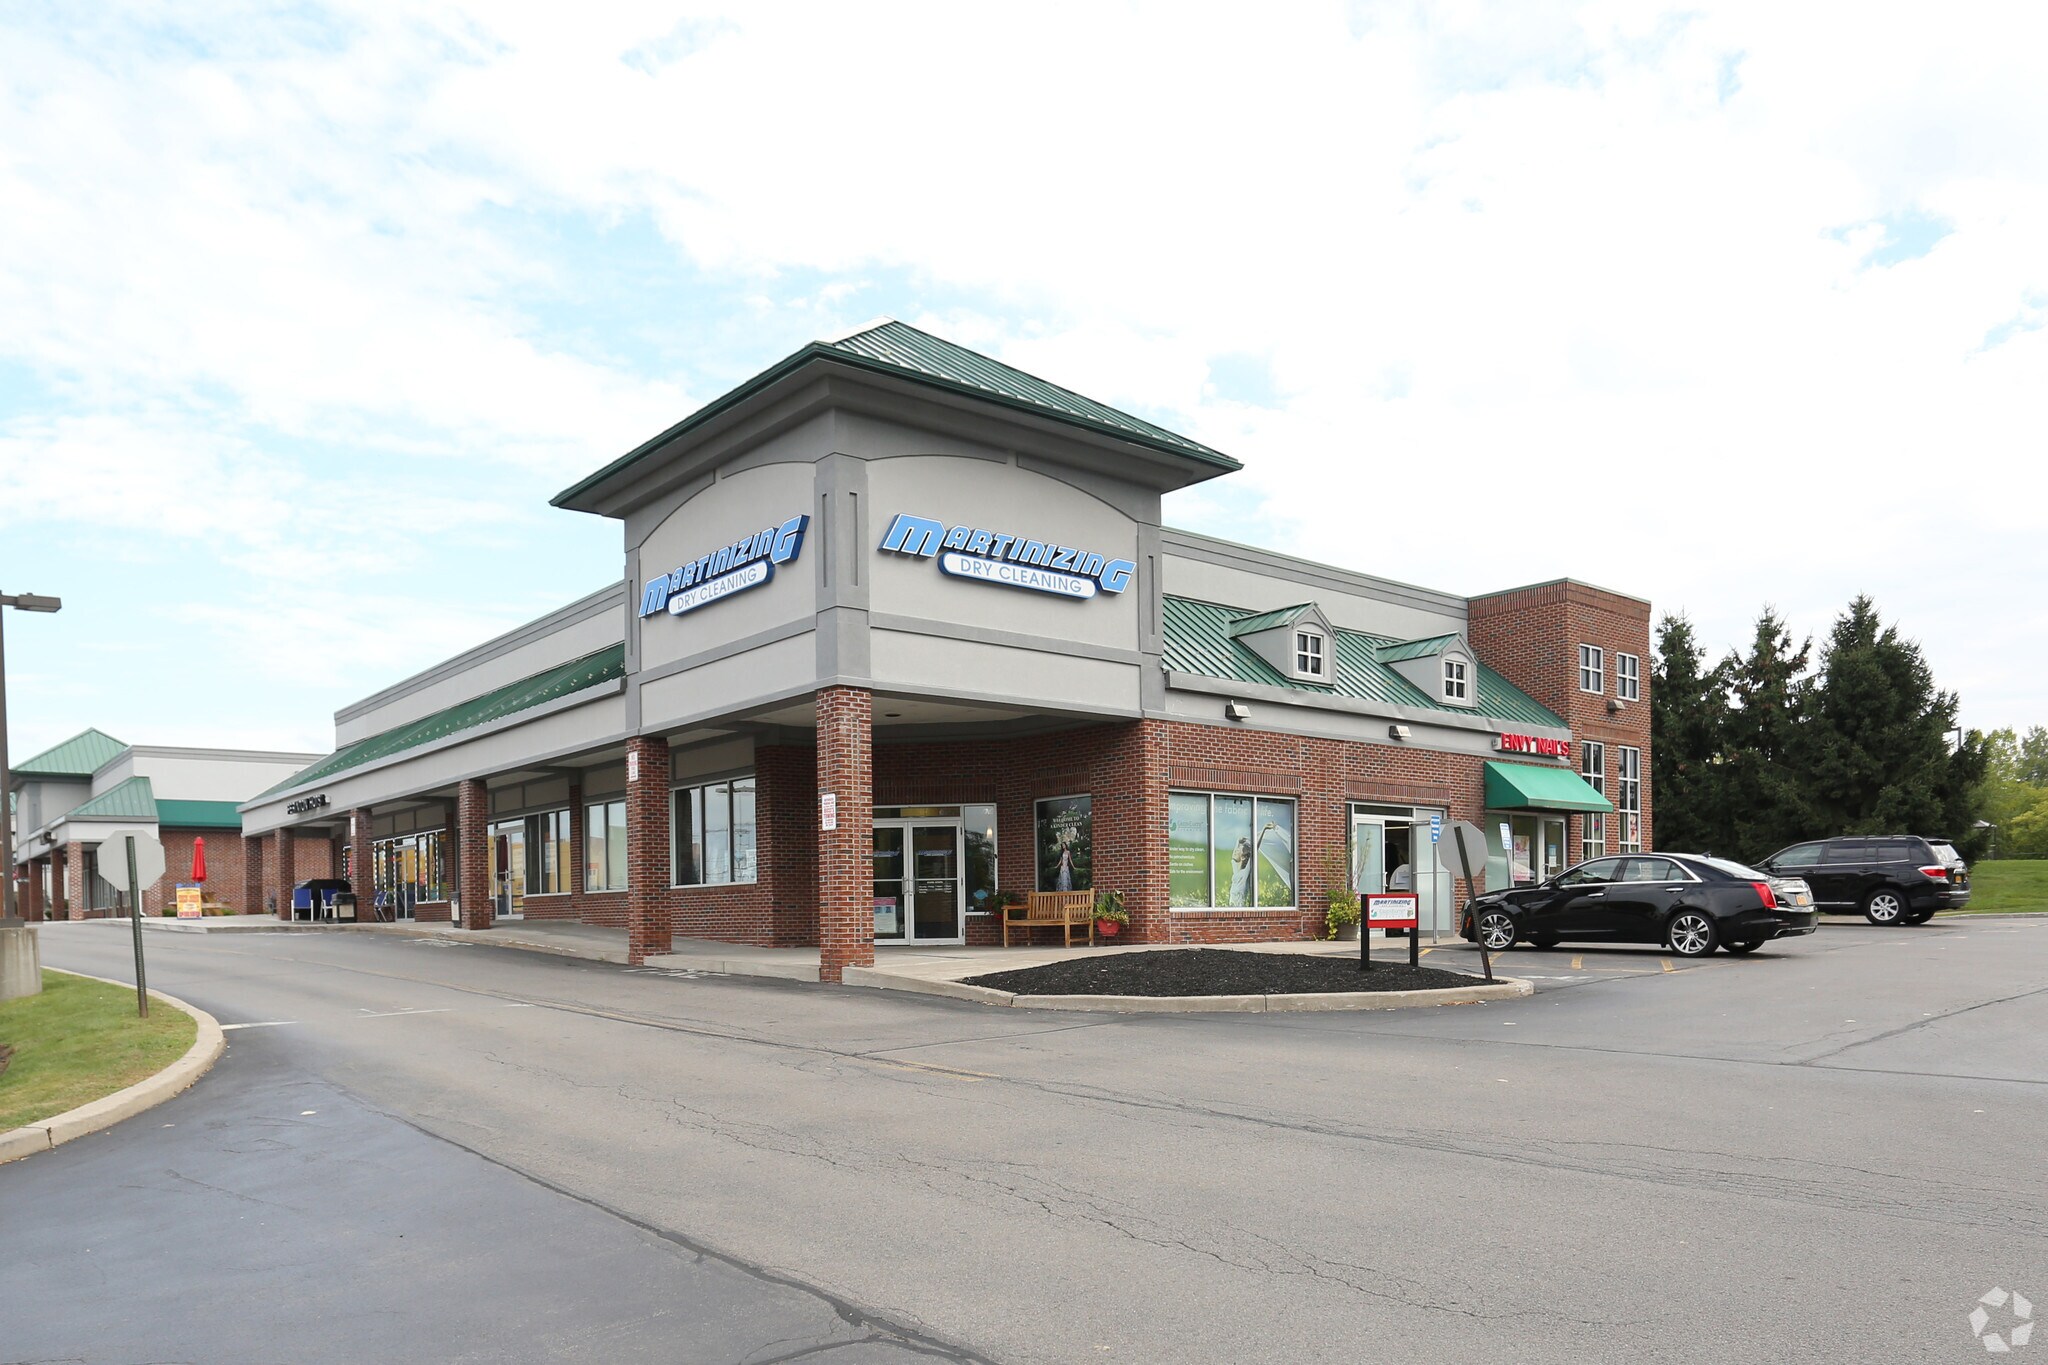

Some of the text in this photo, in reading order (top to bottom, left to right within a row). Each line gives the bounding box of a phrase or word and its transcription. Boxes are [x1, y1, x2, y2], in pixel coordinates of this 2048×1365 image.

[638, 514, 810, 618] MARTINIZING
[879, 513, 1137, 594] MARTINIZING
[677, 568, 757, 610] DRY CLEANING
[960, 558, 1082, 593] DRY CLEANING
[1501, 732, 1570, 756] ENVY NAILS
[1169, 801, 1206, 815] mproving
[1225, 803, 1248, 816] fabric
